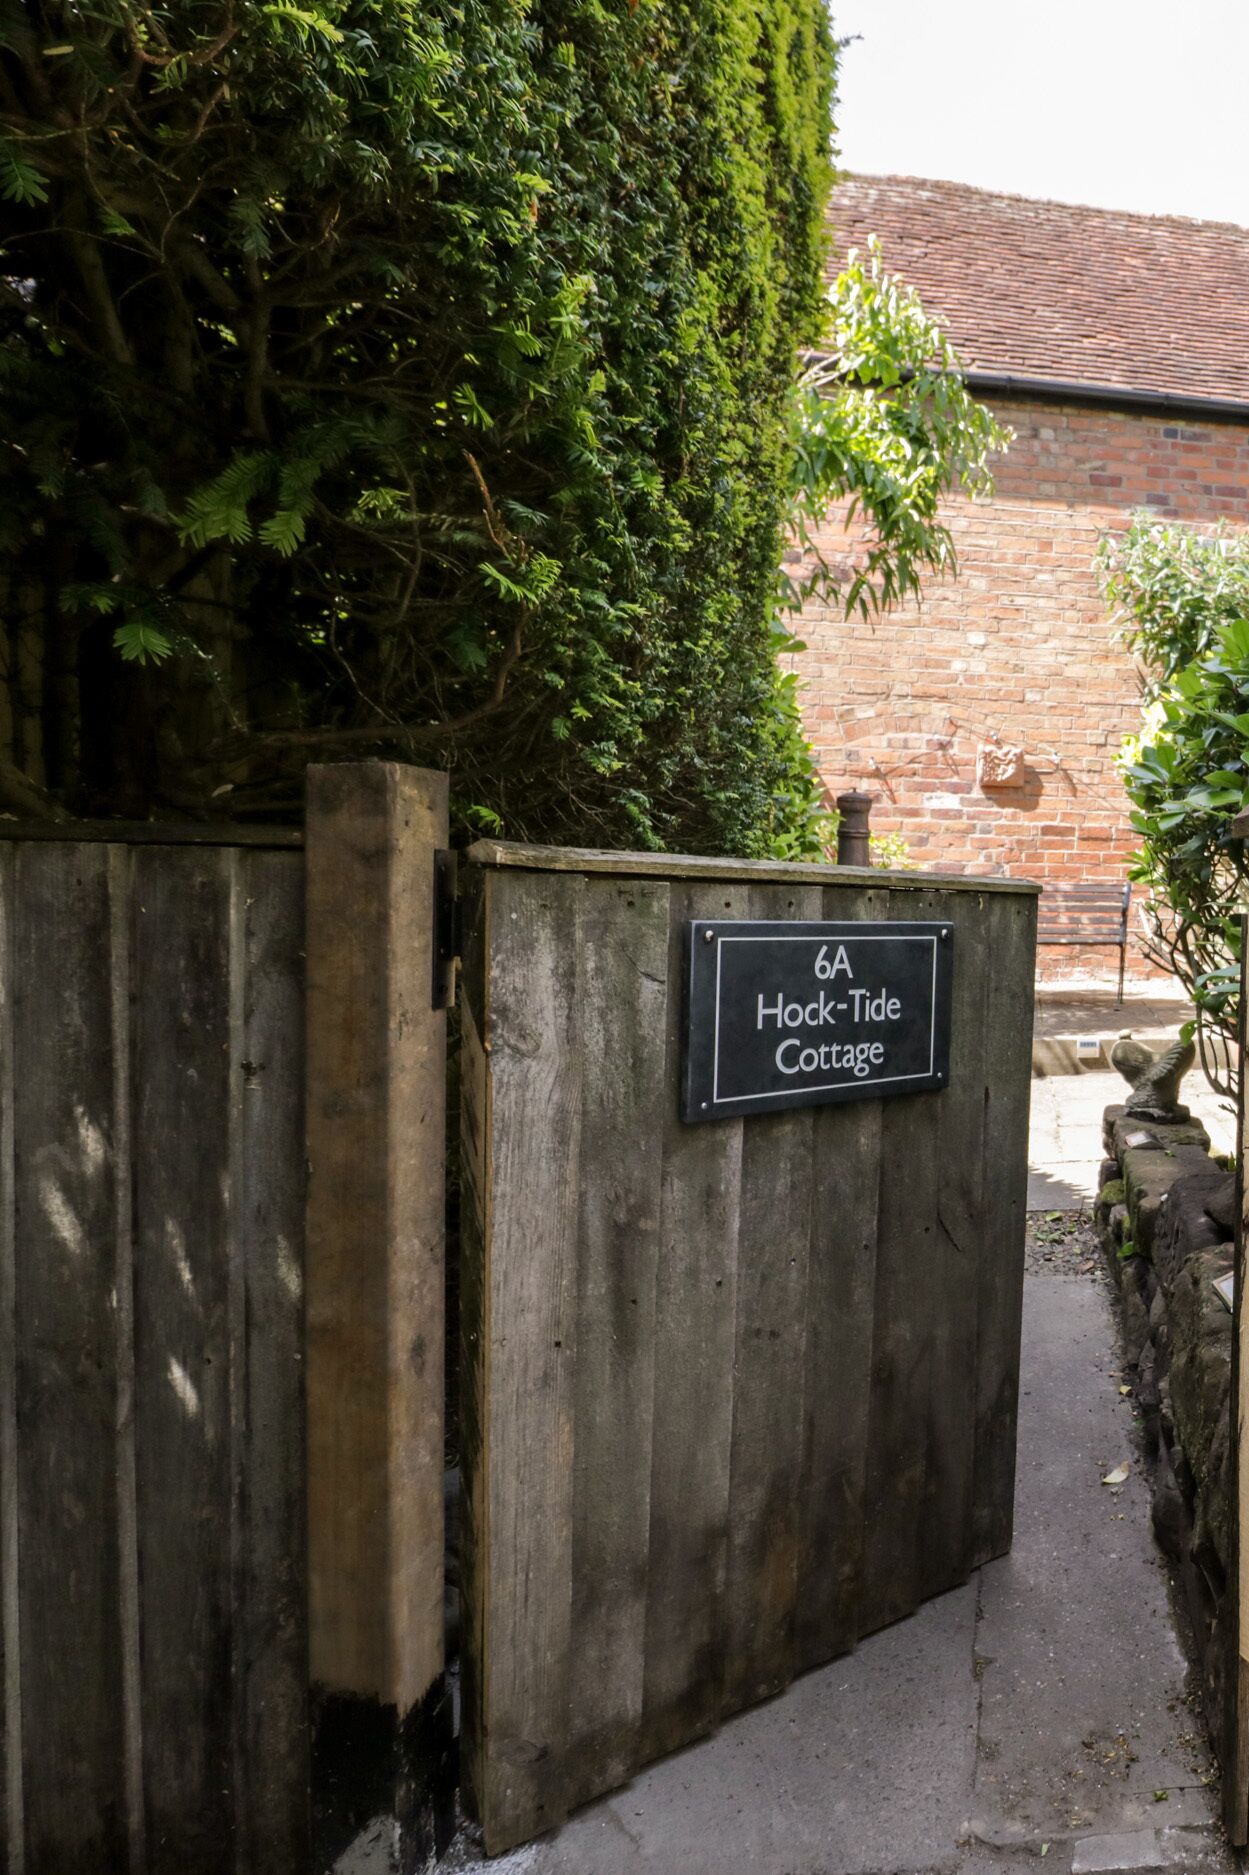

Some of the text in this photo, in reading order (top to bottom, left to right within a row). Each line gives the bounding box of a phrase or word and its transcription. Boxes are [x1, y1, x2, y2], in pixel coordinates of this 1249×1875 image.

[814, 945, 854, 980] 6A
[757, 988, 901, 1030] Hock-Tide
[775, 1038, 884, 1077] Cottage
